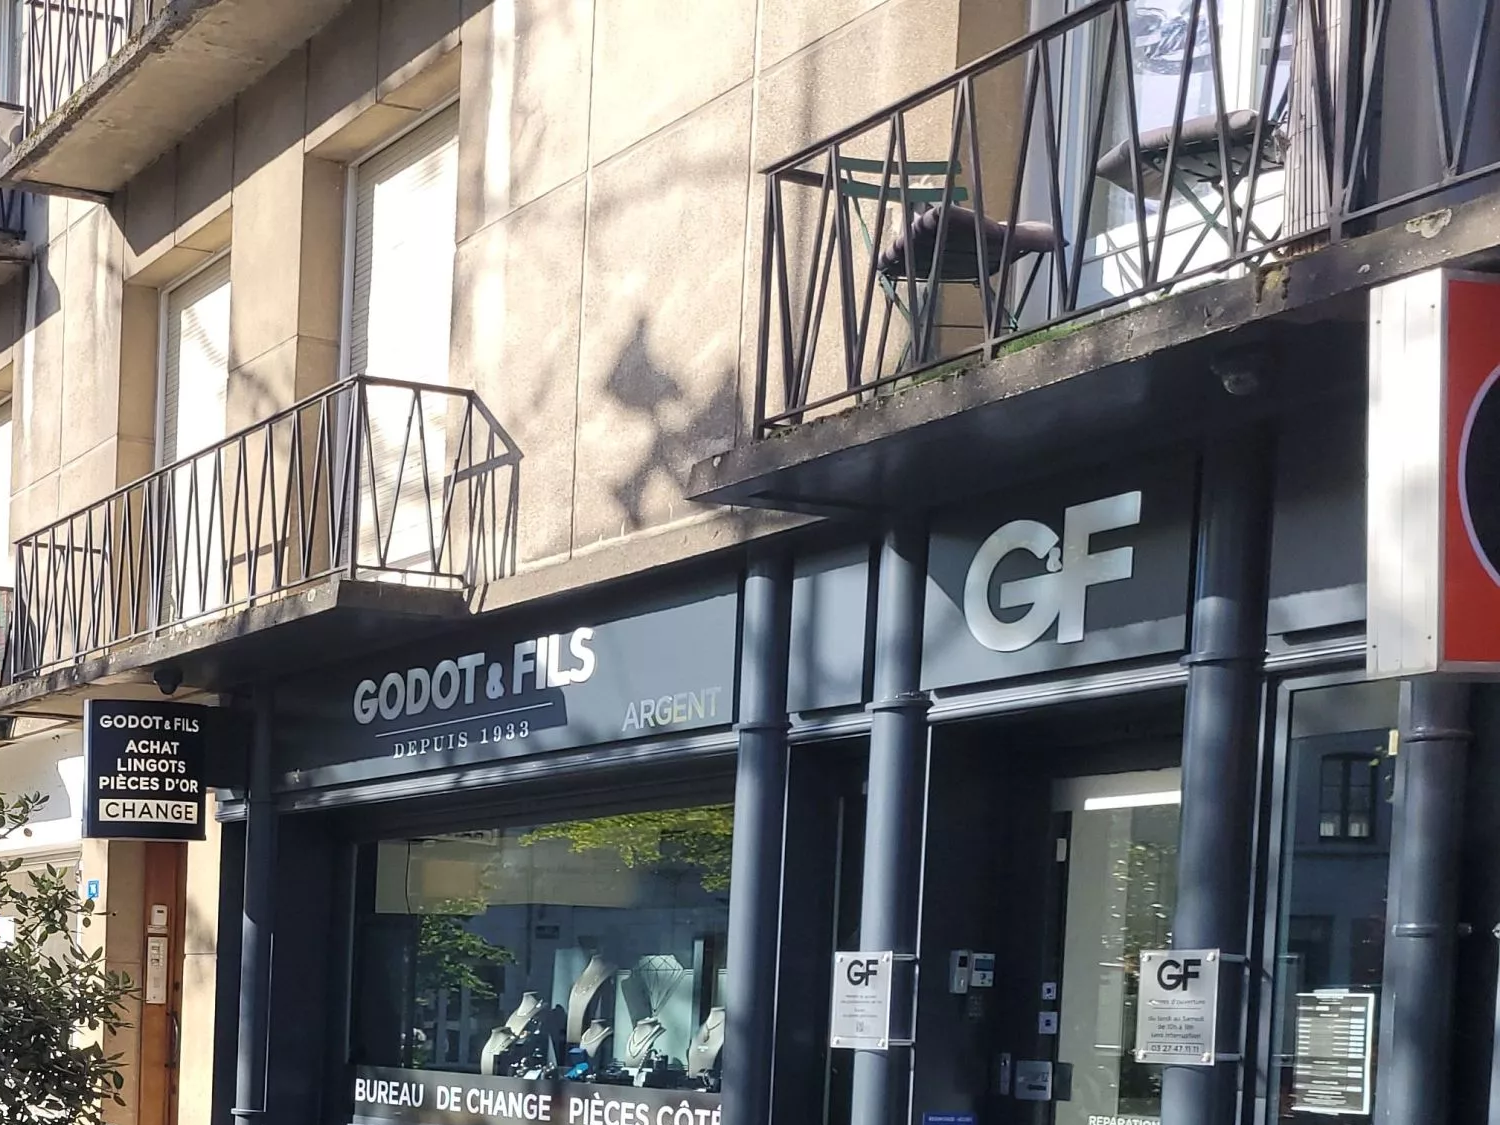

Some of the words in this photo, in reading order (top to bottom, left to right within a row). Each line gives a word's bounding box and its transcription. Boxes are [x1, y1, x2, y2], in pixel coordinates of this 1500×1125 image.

[353, 652, 486, 725] GODOT
[485, 662, 504, 700] &
[512, 627, 598, 696] FILS
[621, 686, 722, 732] ARGENT
[100, 715, 163, 730] GODOT
[164, 720, 171, 730] &
[173, 718, 199, 733] FILS
[125, 740, 180, 755] ACHAT
[393, 731, 469, 760] DEPUIS
[480, 721, 531, 745] 1933
[116, 758, 186, 774] LINGOTS
[99, 773, 160, 791] PIÈCES
[165, 778, 199, 793] D'OR
[105, 802, 194, 821] CHANGE
[847, 959, 879, 987] GF
[1157, 958, 1202, 992] GF
[355, 1078, 424, 1108] BUREAU
[436, 1085, 462, 1112] DE
[465, 1088, 552, 1122] CHANGE
